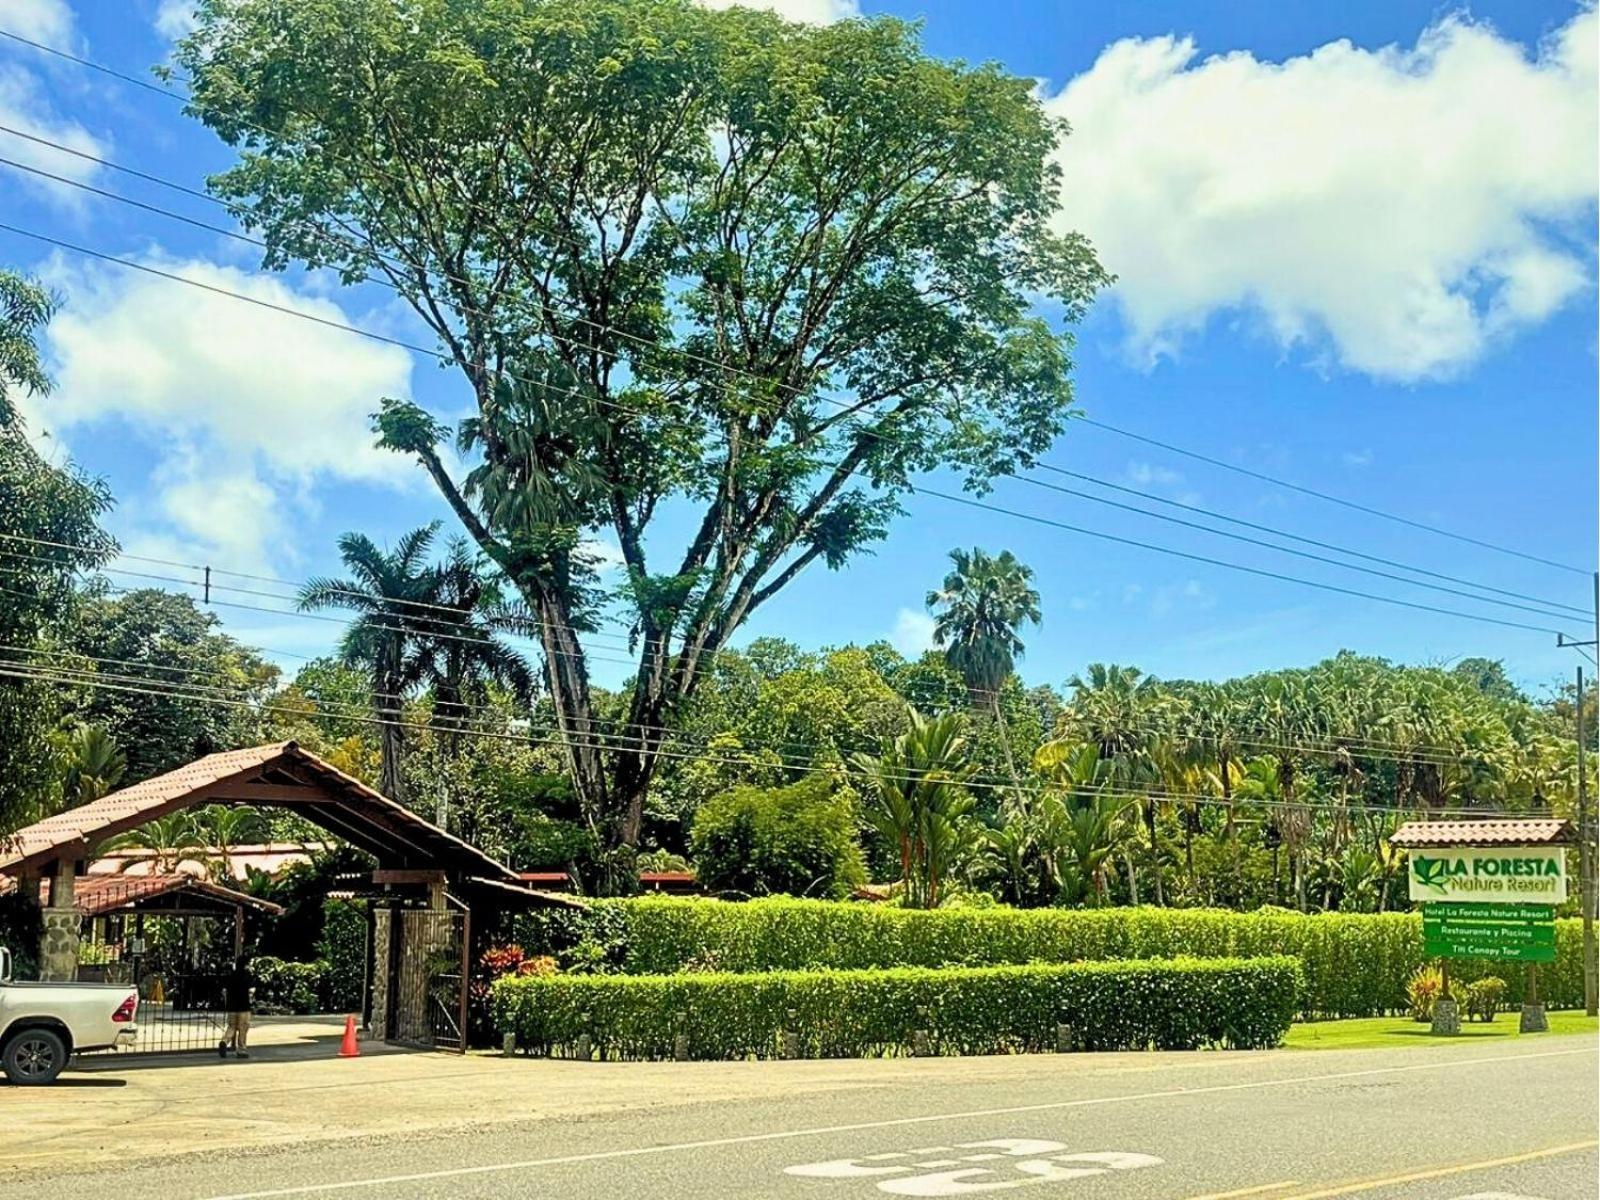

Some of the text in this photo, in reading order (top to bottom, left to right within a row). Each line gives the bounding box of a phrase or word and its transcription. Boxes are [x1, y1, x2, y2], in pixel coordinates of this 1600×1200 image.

[1444, 858, 1560, 876] LA FORESTA
[1450, 878, 1556, 893] Nature Resort
[1424, 908, 1549, 918] Hotel La Foresta Nature Resort
[1441, 926, 1533, 938] Restaurante y Piscina
[1467, 946, 1500, 956] Canopy
[1502, 947, 1521, 956] Tour
